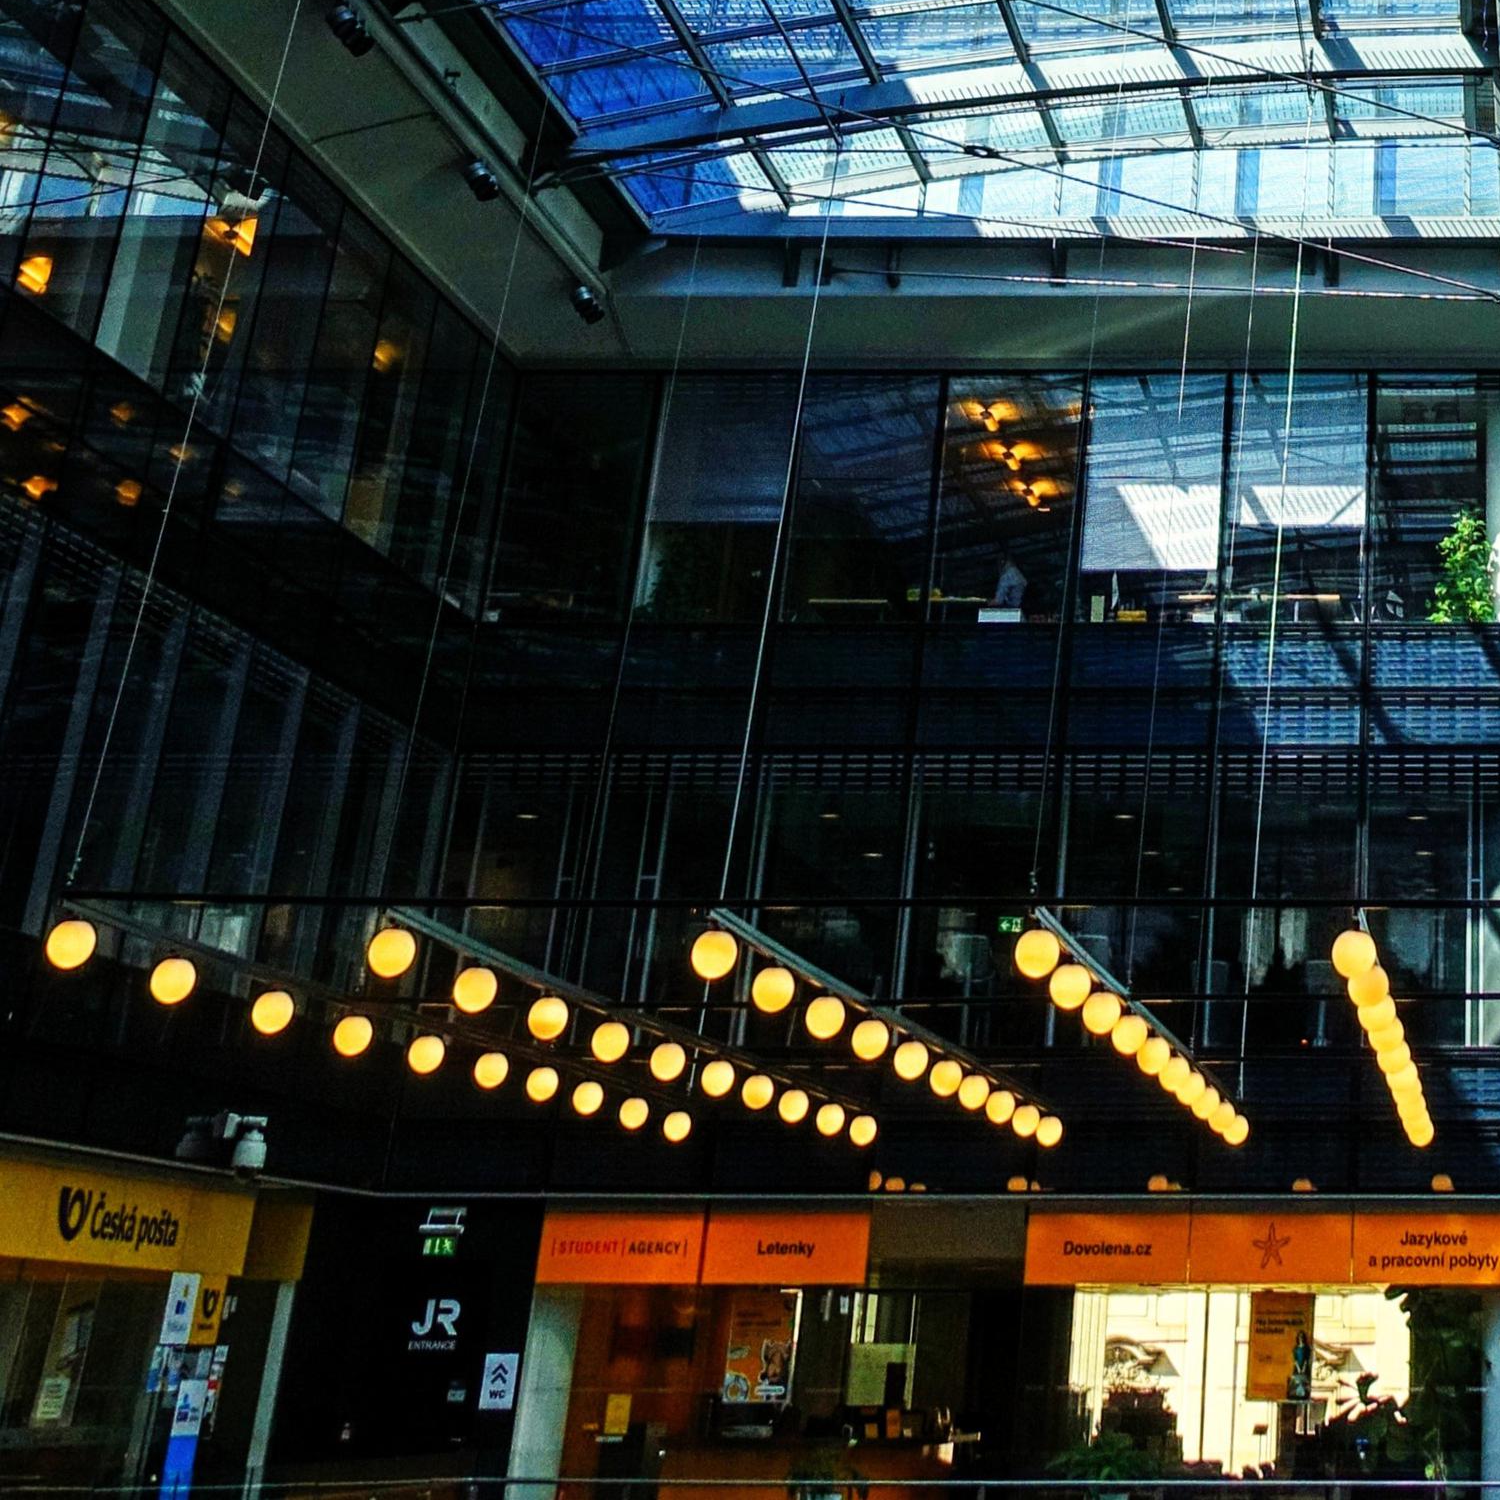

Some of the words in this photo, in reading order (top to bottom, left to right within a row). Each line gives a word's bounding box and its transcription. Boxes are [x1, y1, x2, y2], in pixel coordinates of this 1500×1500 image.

[90, 1191, 138, 1242] Česká
[134, 1209, 179, 1251] pošta
[559, 1240, 618, 1254] STUDENT
[628, 1241, 681, 1254] AGENCY
[757, 1239, 816, 1258] Letenky
[1063, 1240, 1152, 1256] Dovolena.cz
[1399, 1230, 1468, 1249] Jazykové
[1368, 1255, 1377, 1267] a
[1381, 1252, 1445, 1271] pracovní
[1449, 1252, 1499, 1271] pobyty
[411, 1298, 461, 1335] JR
[408, 1339, 457, 1350] ENTRANCE
[488, 1389, 506, 1399] WC
